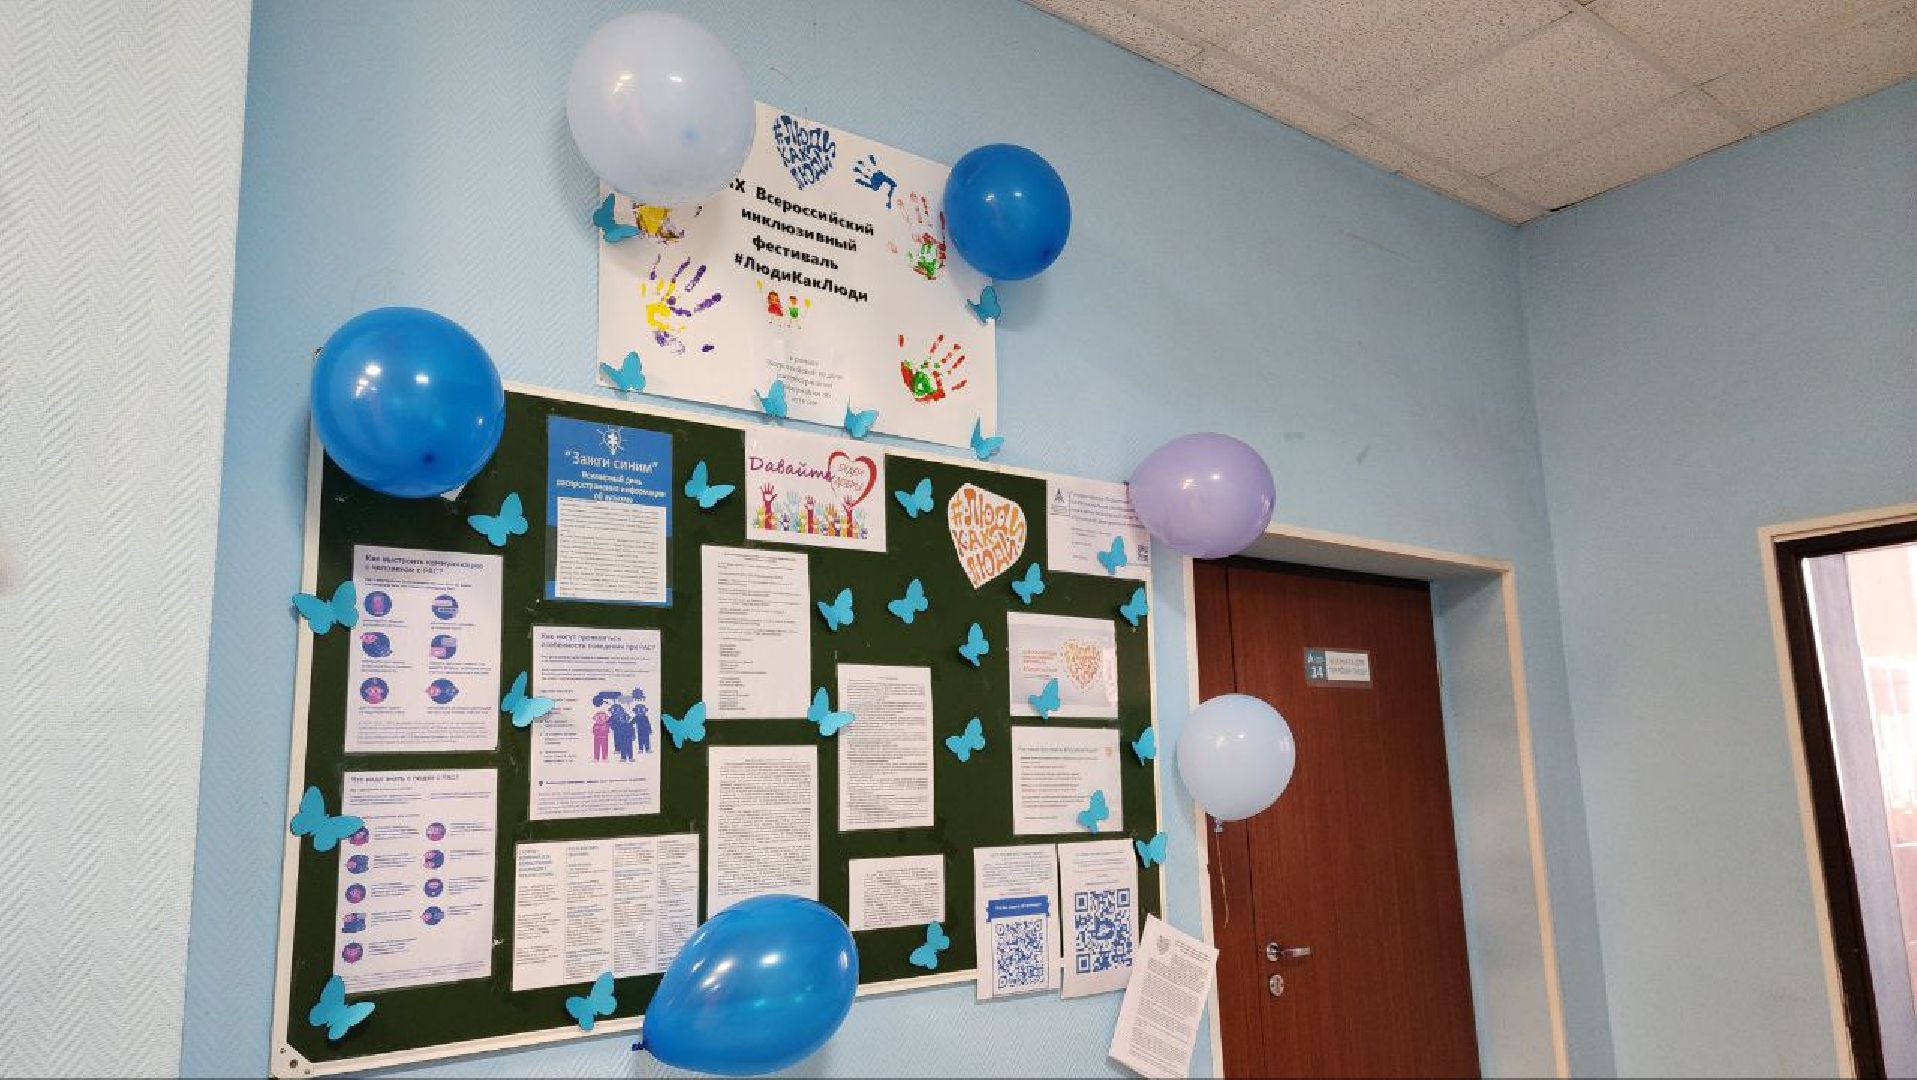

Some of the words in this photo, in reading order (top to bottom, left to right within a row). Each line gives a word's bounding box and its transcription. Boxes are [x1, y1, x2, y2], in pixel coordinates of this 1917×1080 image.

[741, 208, 857, 252] инклюзивный
[756, 187, 874, 236] Всероссийский
[752, 235, 838, 270] фестиваль
[734, 253, 868, 301] #ЛюдиКакЛюди
